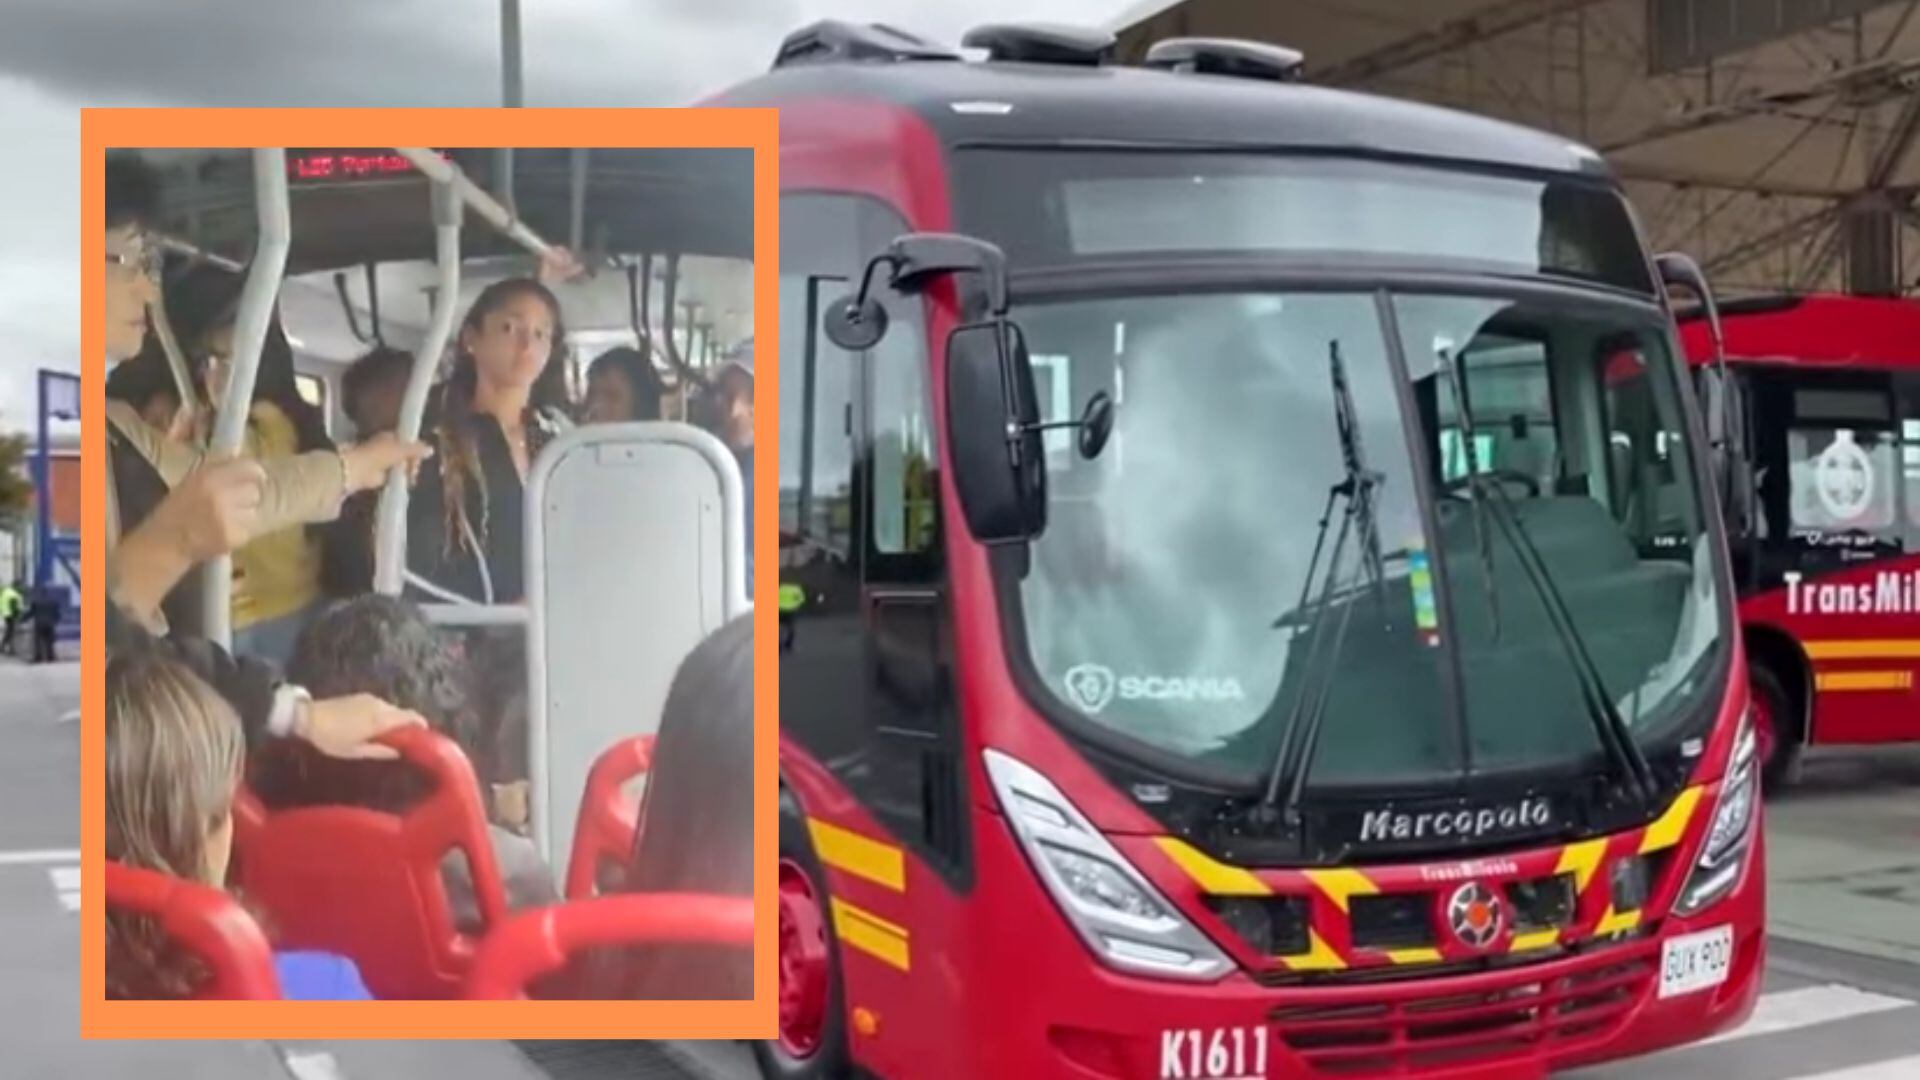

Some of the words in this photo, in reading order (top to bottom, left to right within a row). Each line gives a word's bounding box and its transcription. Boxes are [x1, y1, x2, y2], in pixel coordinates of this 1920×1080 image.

[1118, 676, 1245, 699] SCANIA
[1360, 800, 1550, 841] Marcopolo
[1160, 1024, 1268, 1078] K1611
